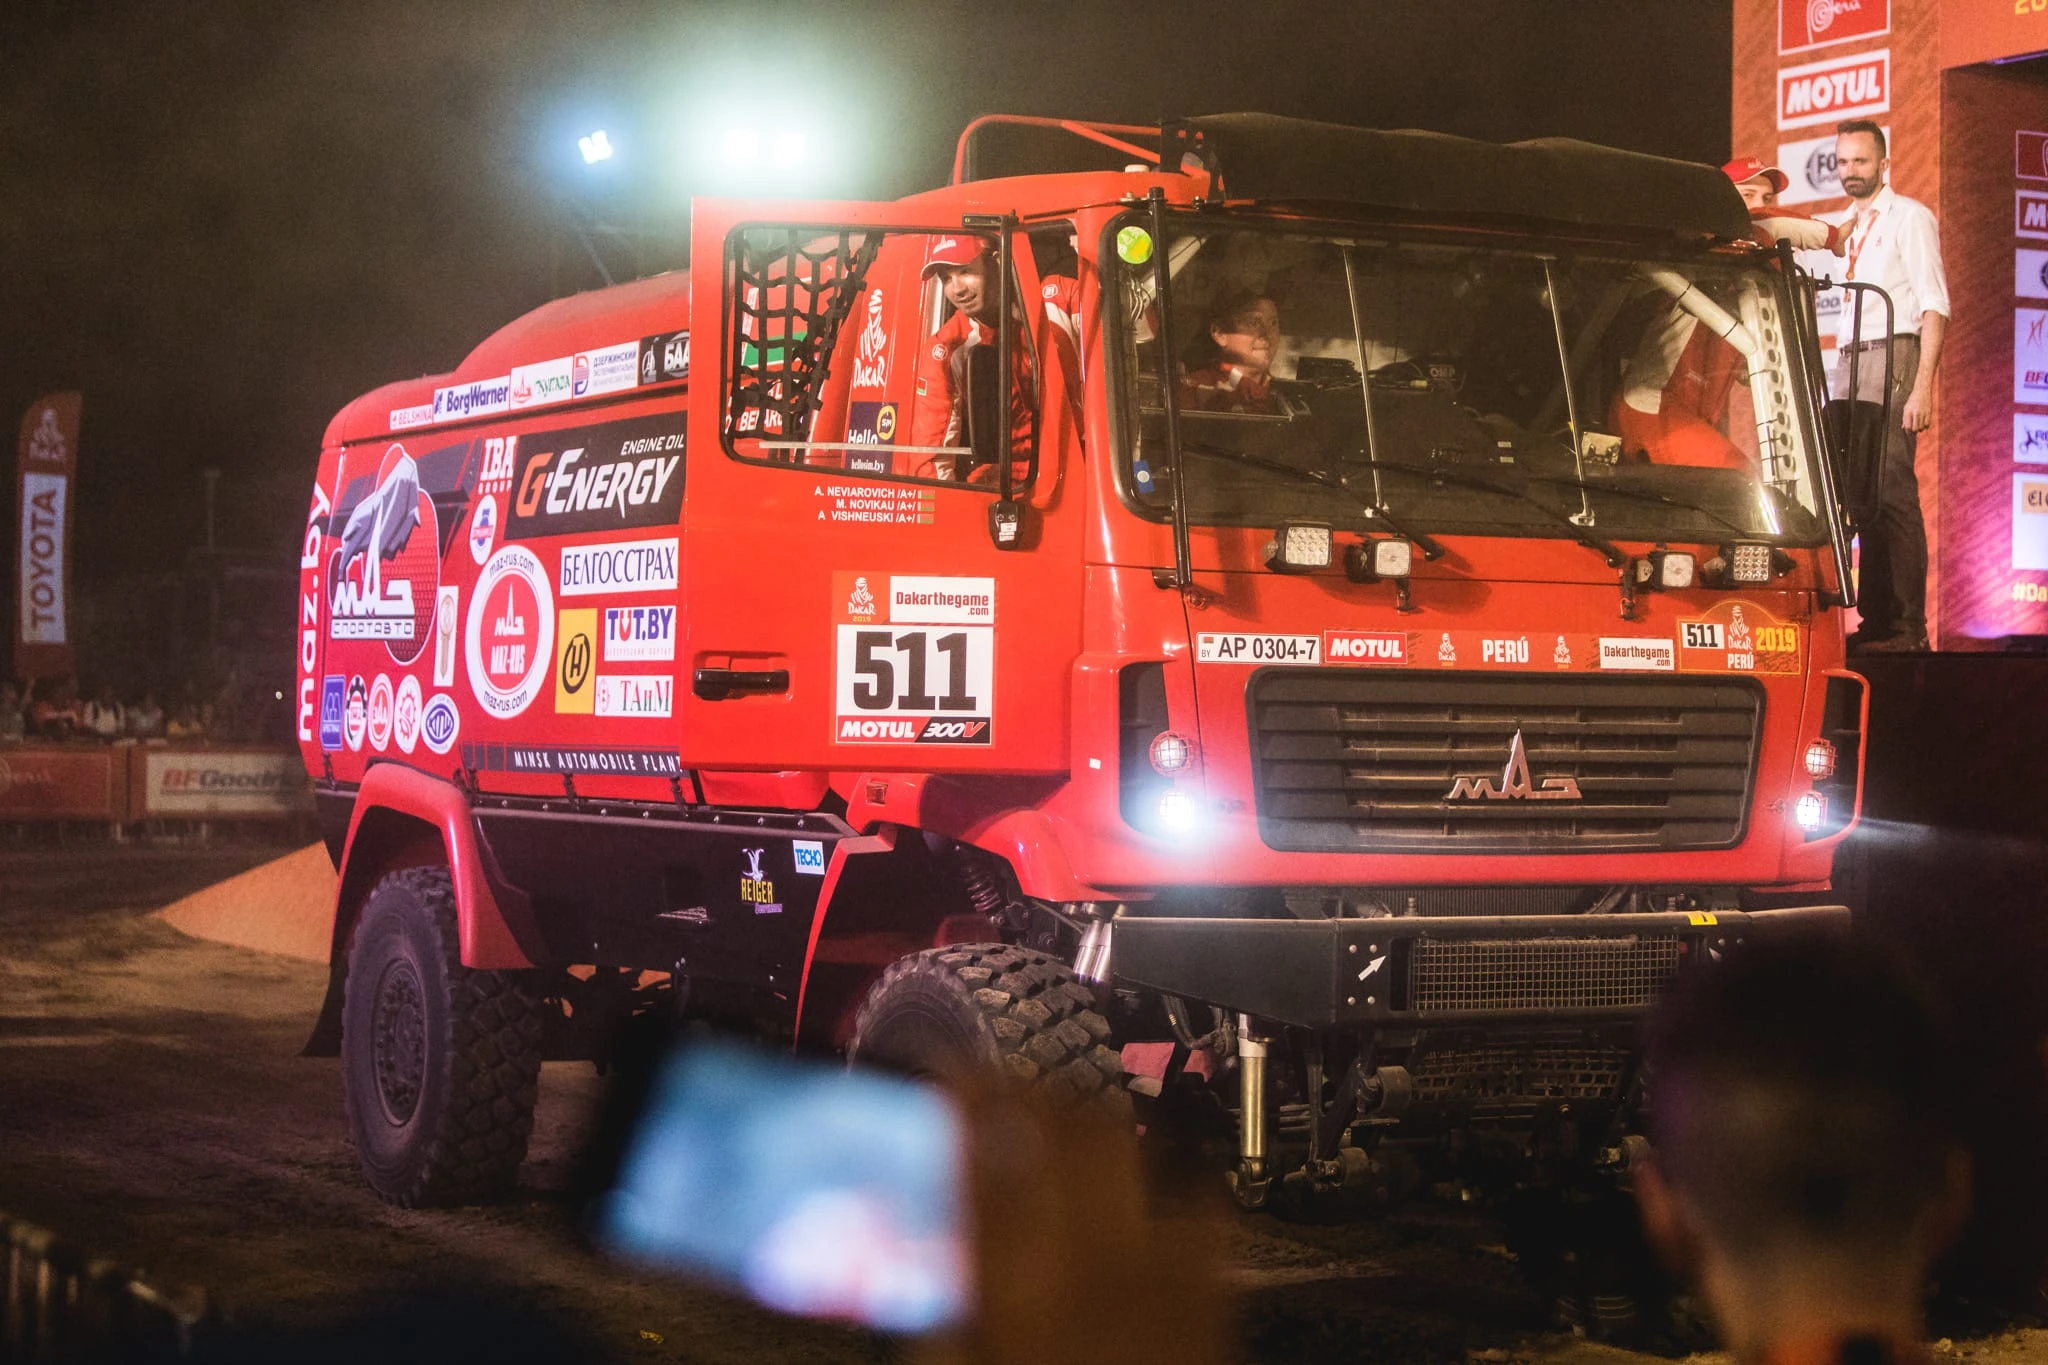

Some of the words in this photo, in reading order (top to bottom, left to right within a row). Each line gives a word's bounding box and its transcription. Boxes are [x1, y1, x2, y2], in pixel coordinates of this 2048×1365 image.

[1786, 66, 1880, 114] MOTUL
[1817, 153, 1838, 174] FO
[853, 356, 887, 388] DAKAR
[446, 385, 508, 414] BorgWarner
[620, 437, 665, 456] ENGINE
[665, 433, 685, 451] OIL
[848, 429, 878, 445] Hello
[480, 435, 517, 481] IBA
[478, 480, 513, 494] GROUP
[814, 486, 824, 496] A.
[827, 486, 895, 499] NEVIAROVICH
[836, 499, 847, 509] M.
[850, 500, 894, 511] NOVIKAU
[831, 511, 894, 523] VISHNEUSKI
[31, 488, 57, 629] TOYOTA
[489, 553, 535, 578] maz-rus.com
[563, 546, 675, 586] БЕЛГОССТРАХ
[848, 602, 876, 615] DAKAR
[896, 592, 989, 608] Dakarthegame
[299, 482, 330, 741] maz.by
[967, 607, 989, 616] .com
[333, 621, 413, 636] СПОРТАВТО
[607, 608, 674, 641] TUT.BY
[1686, 624, 1718, 648] 511
[1727, 635, 1753, 650] DAKAR
[1755, 627, 1796, 652] 2019
[490, 644, 525, 675] MAZ-RUS
[1201, 649, 1211, 658] BY
[1218, 637, 1247, 658] AP
[1252, 638, 1316, 660] 0304-7
[1330, 639, 1403, 658] MOTUL
[1482, 636, 1529, 663] PERÚ
[1603, 645, 1670, 660] Dakarthegame
[853, 631, 977, 711] 511
[1727, 652, 1754, 669] PERÚ
[483, 690, 528, 712] maz-rus.com
[841, 721, 915, 738] MOTUL
[923, 721, 987, 738] 300V
[514, 751, 551, 768] MINSK
[557, 752, 637, 771] AUTOMOBILE
[741, 878, 773, 904] REIGER
